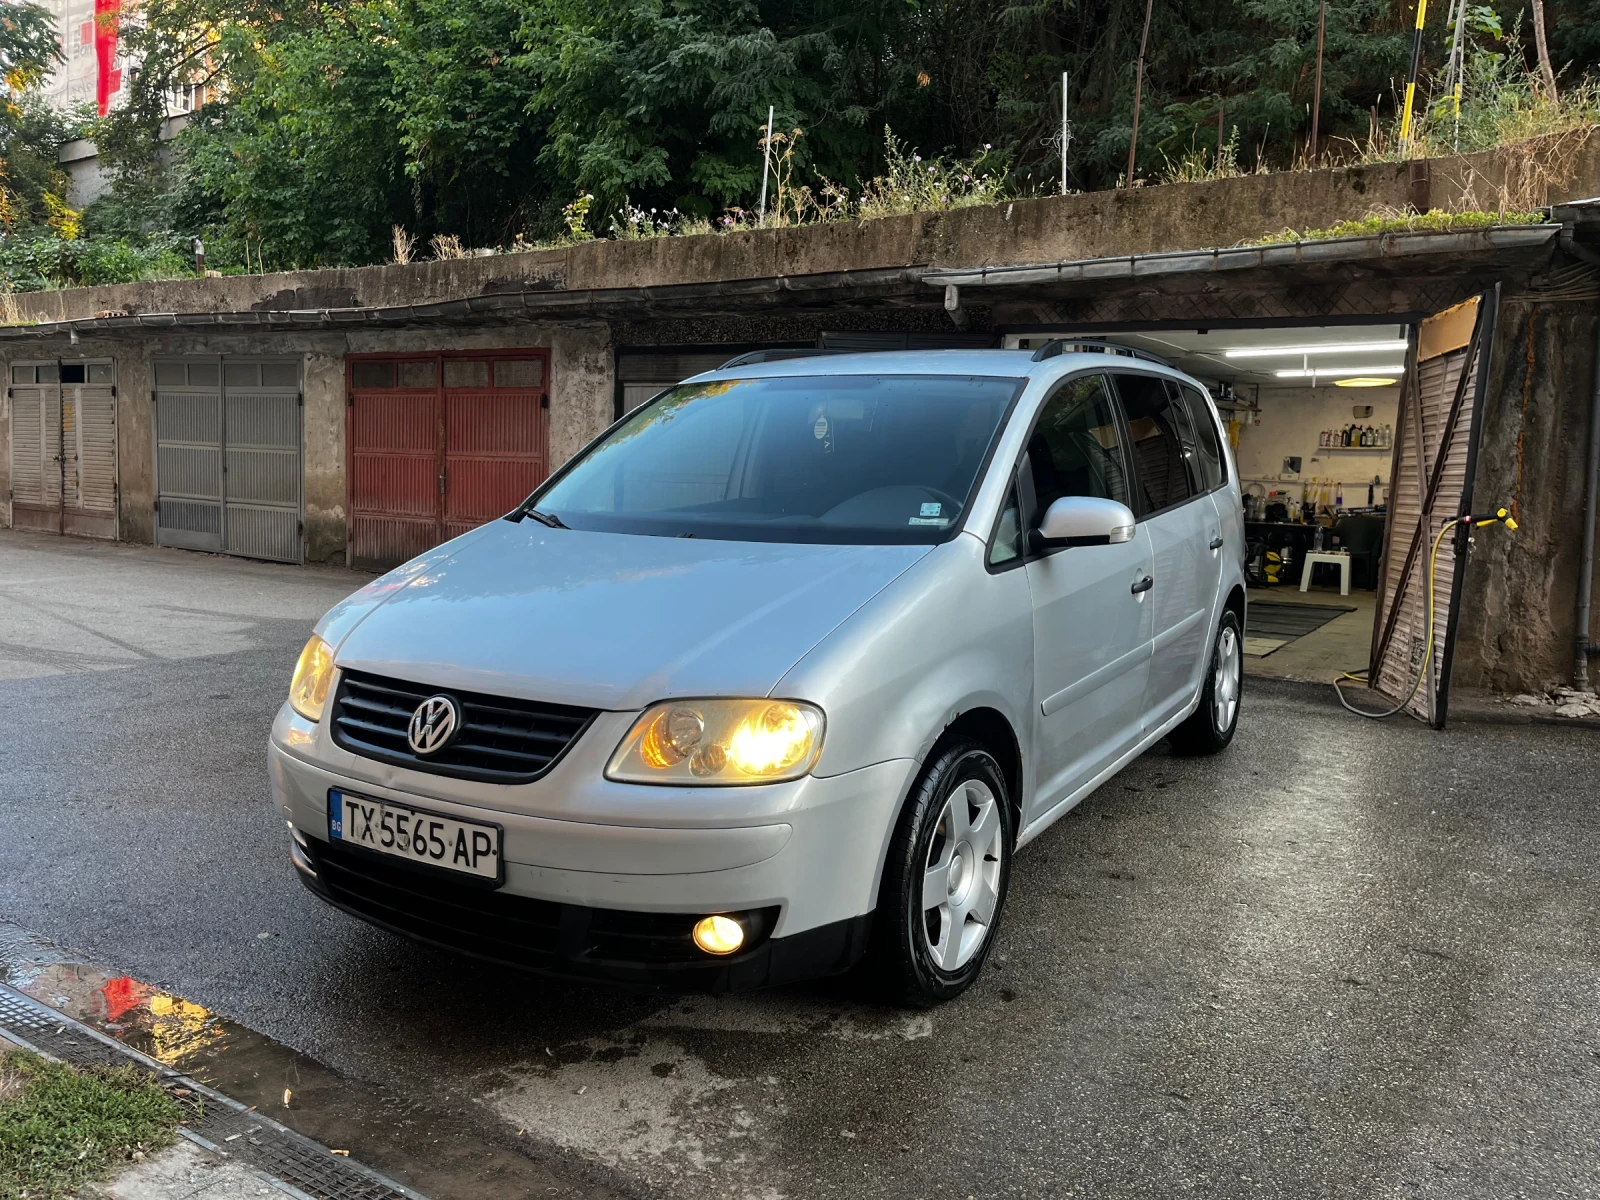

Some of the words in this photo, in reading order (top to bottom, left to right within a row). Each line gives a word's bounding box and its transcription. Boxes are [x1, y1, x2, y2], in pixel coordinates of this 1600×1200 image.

[408, 697, 455, 754] VW
[331, 819, 342, 832] BG
[345, 800, 375, 844] TX
[380, 811, 446, 860] 5565
[453, 827, 491, 868] AP
